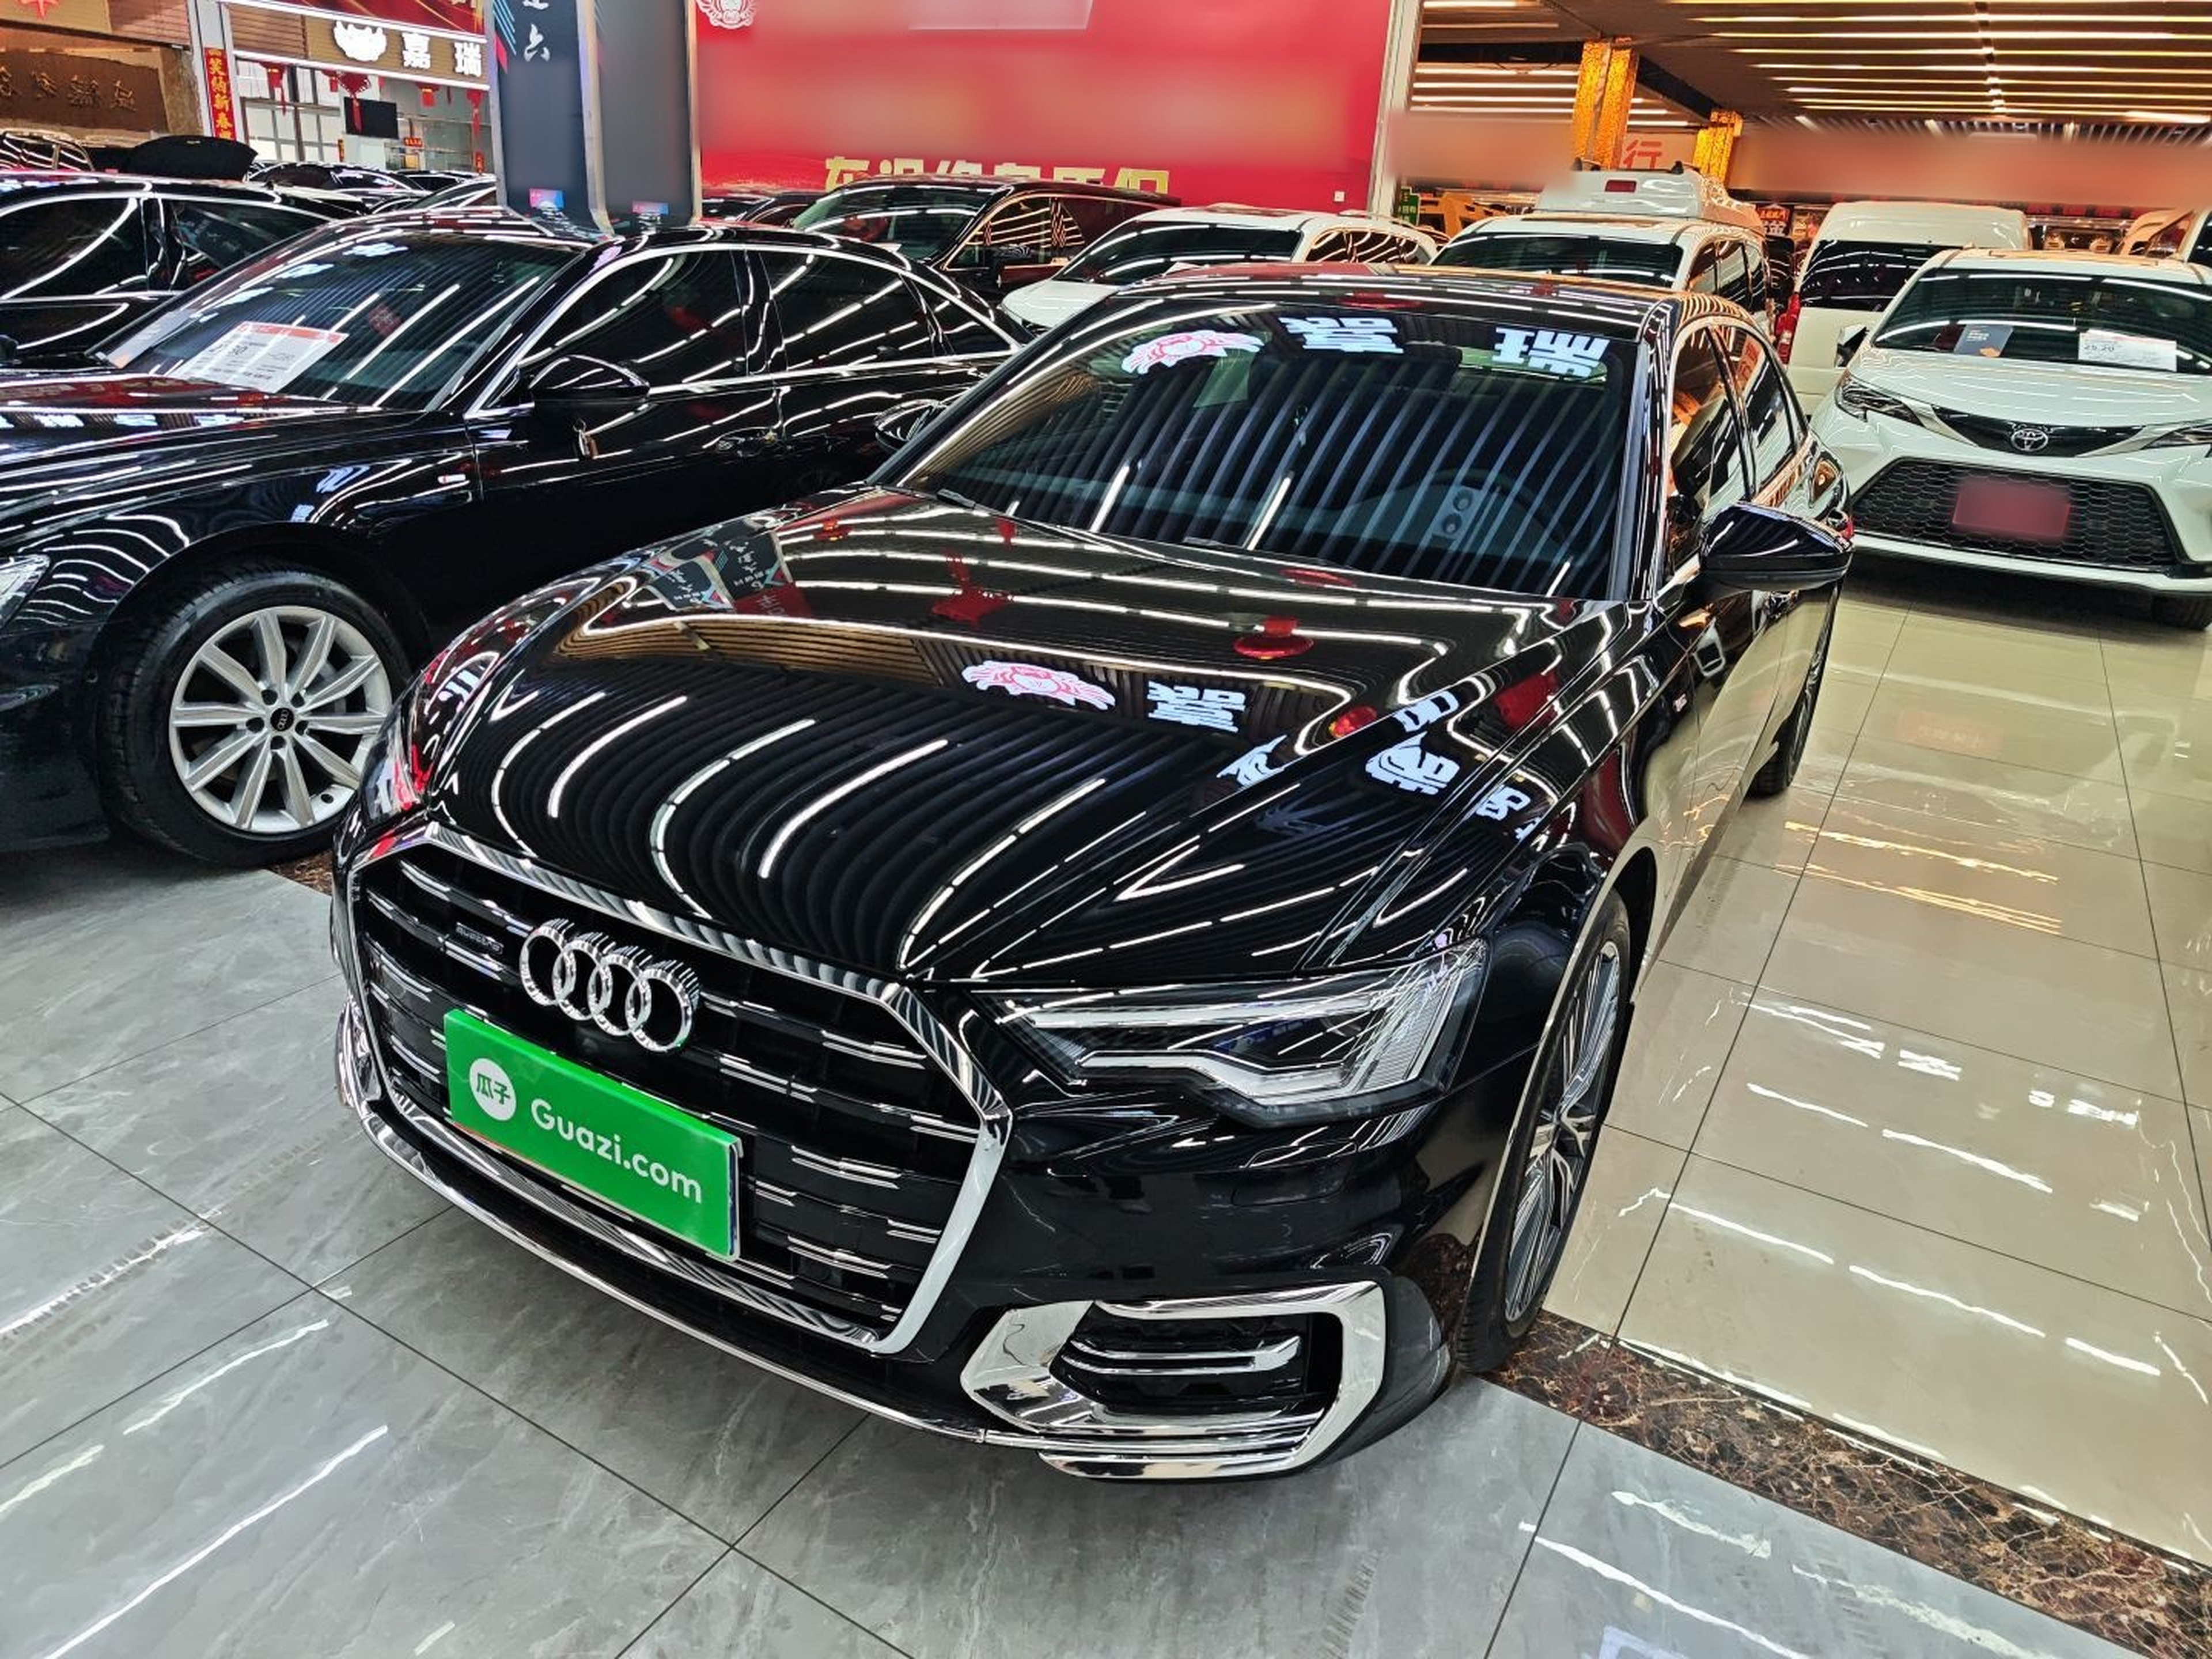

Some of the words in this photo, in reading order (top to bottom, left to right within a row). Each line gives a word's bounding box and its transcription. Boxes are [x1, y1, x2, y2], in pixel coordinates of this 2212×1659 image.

[402, 32, 482, 77] 嘉瑞
[475, 1072, 511, 1105] 瓜子
[530, 1098, 702, 1203] Guazi.com
